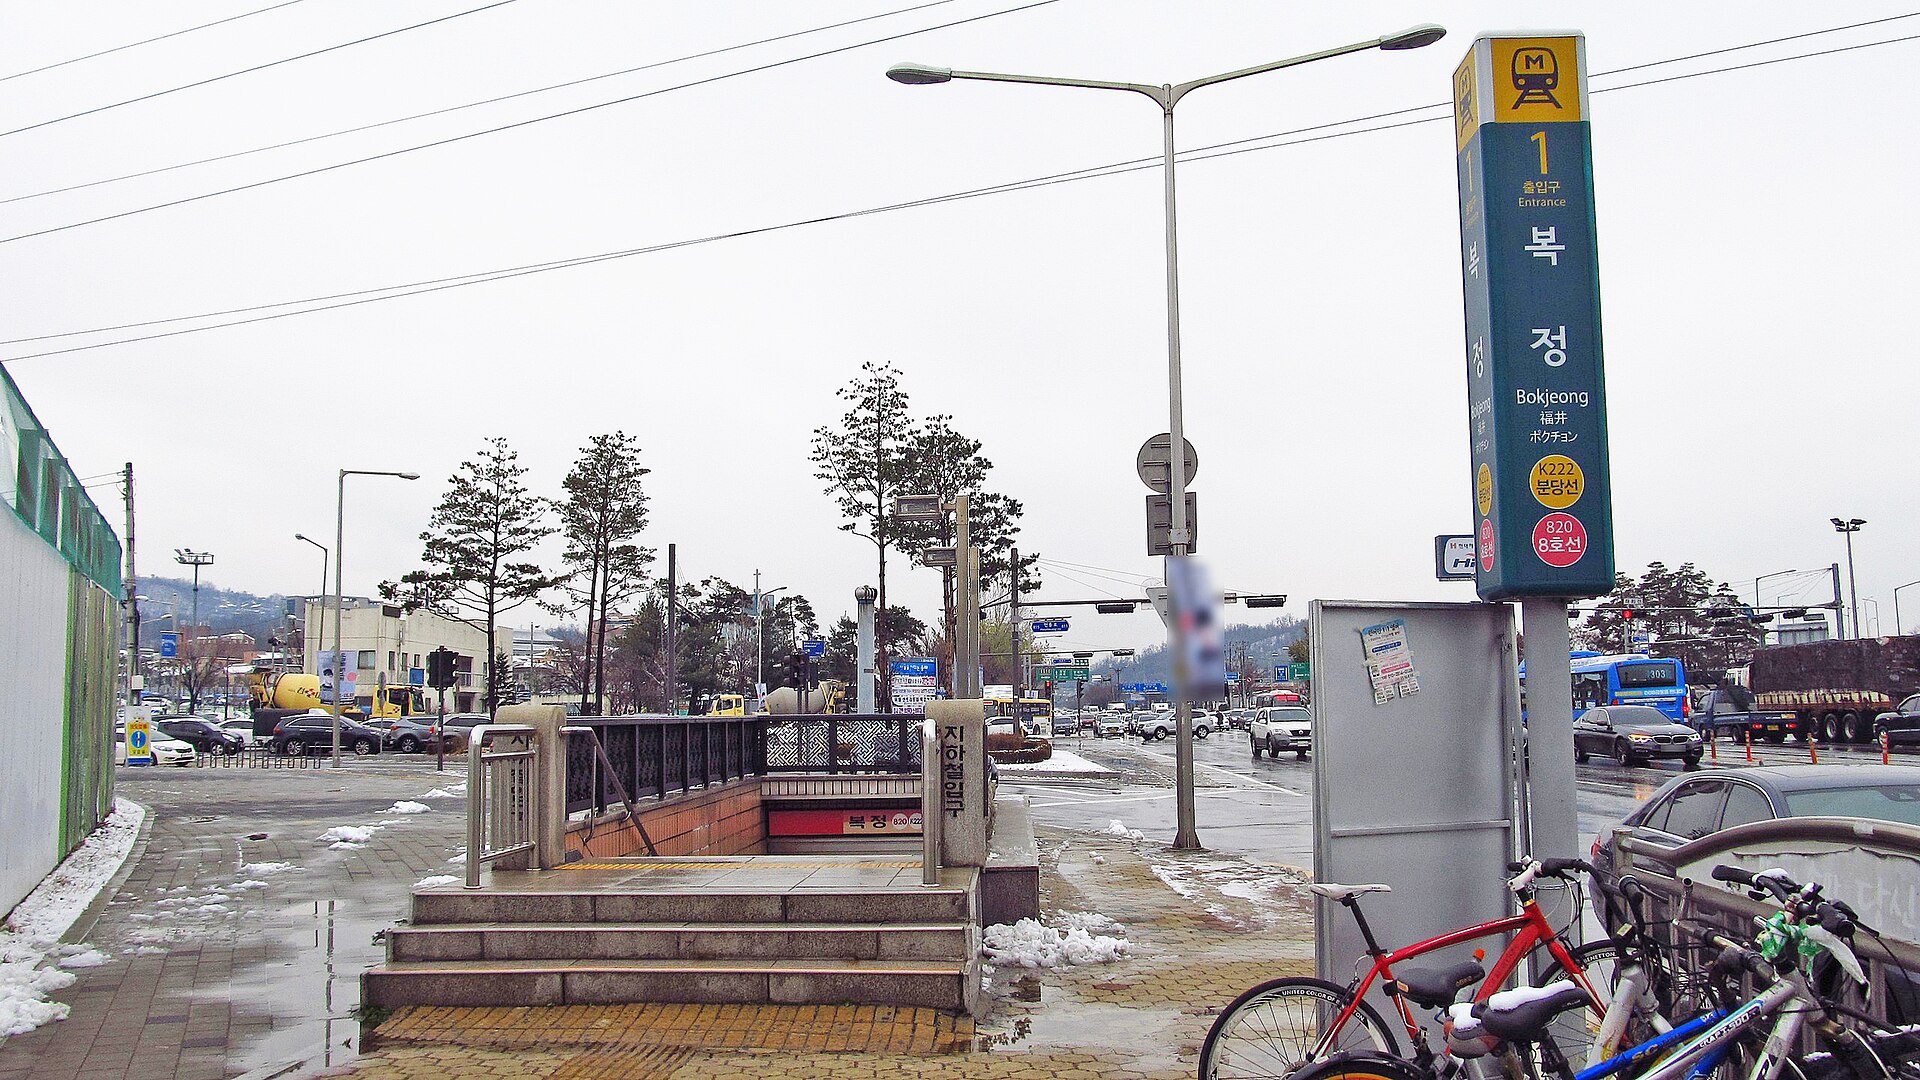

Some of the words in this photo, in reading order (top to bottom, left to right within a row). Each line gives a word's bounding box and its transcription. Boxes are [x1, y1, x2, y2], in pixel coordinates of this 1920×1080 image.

[1530, 131, 1548, 175] 1
[1523, 181, 1561, 194] 출입구
[1518, 197, 1566, 207] Entrance
[1516, 388, 1589, 407] Bokjeong
[1540, 410, 1568, 425] 福井
[1539, 463, 1574, 475] K222
[1536, 479, 1578, 495] 분당선
[1546, 520, 1573, 533] 820
[1538, 536, 1581, 553] 8호선
[1650, 670, 1666, 679] 303
[944, 725, 965, 818] 지하철입구
[893, 817, 908, 826] 820
[1306, 990, 1327, 999] COLOR
